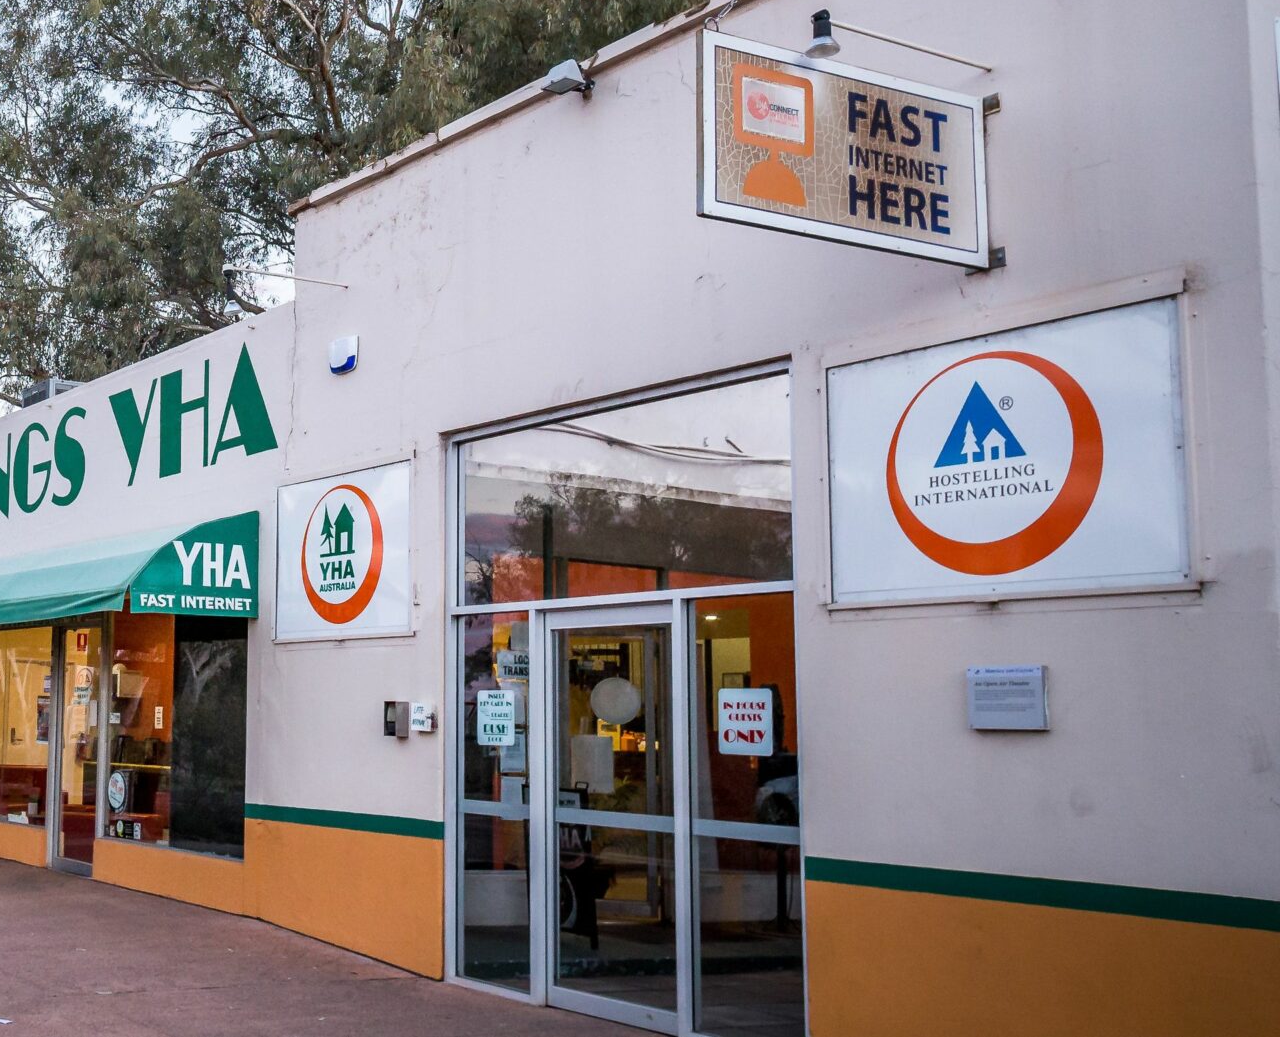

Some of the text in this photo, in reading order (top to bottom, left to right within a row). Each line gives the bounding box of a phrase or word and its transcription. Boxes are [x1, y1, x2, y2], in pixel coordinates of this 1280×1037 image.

[769, 104, 799, 116] CONNECT
[848, 91, 948, 153] FAST
[848, 144, 948, 186] INTERNET
[849, 175, 951, 235] HERE
[108, 340, 279, 487] YHA
[928, 463, 1036, 488] HOSTELLING
[914, 479, 1054, 507] INTERNATIONAL
[173, 540, 251, 590] YHA
[319, 559, 356, 581] YHA
[319, 580, 356, 593] AUSTRALIA
[139, 593, 253, 612] FAST INTERNET
[723, 701, 767, 710] IN HOUSE
[483, 723, 508, 734] PUSH
[728, 713, 763, 722] GUESTS
[723, 728, 767, 744] ONLY
